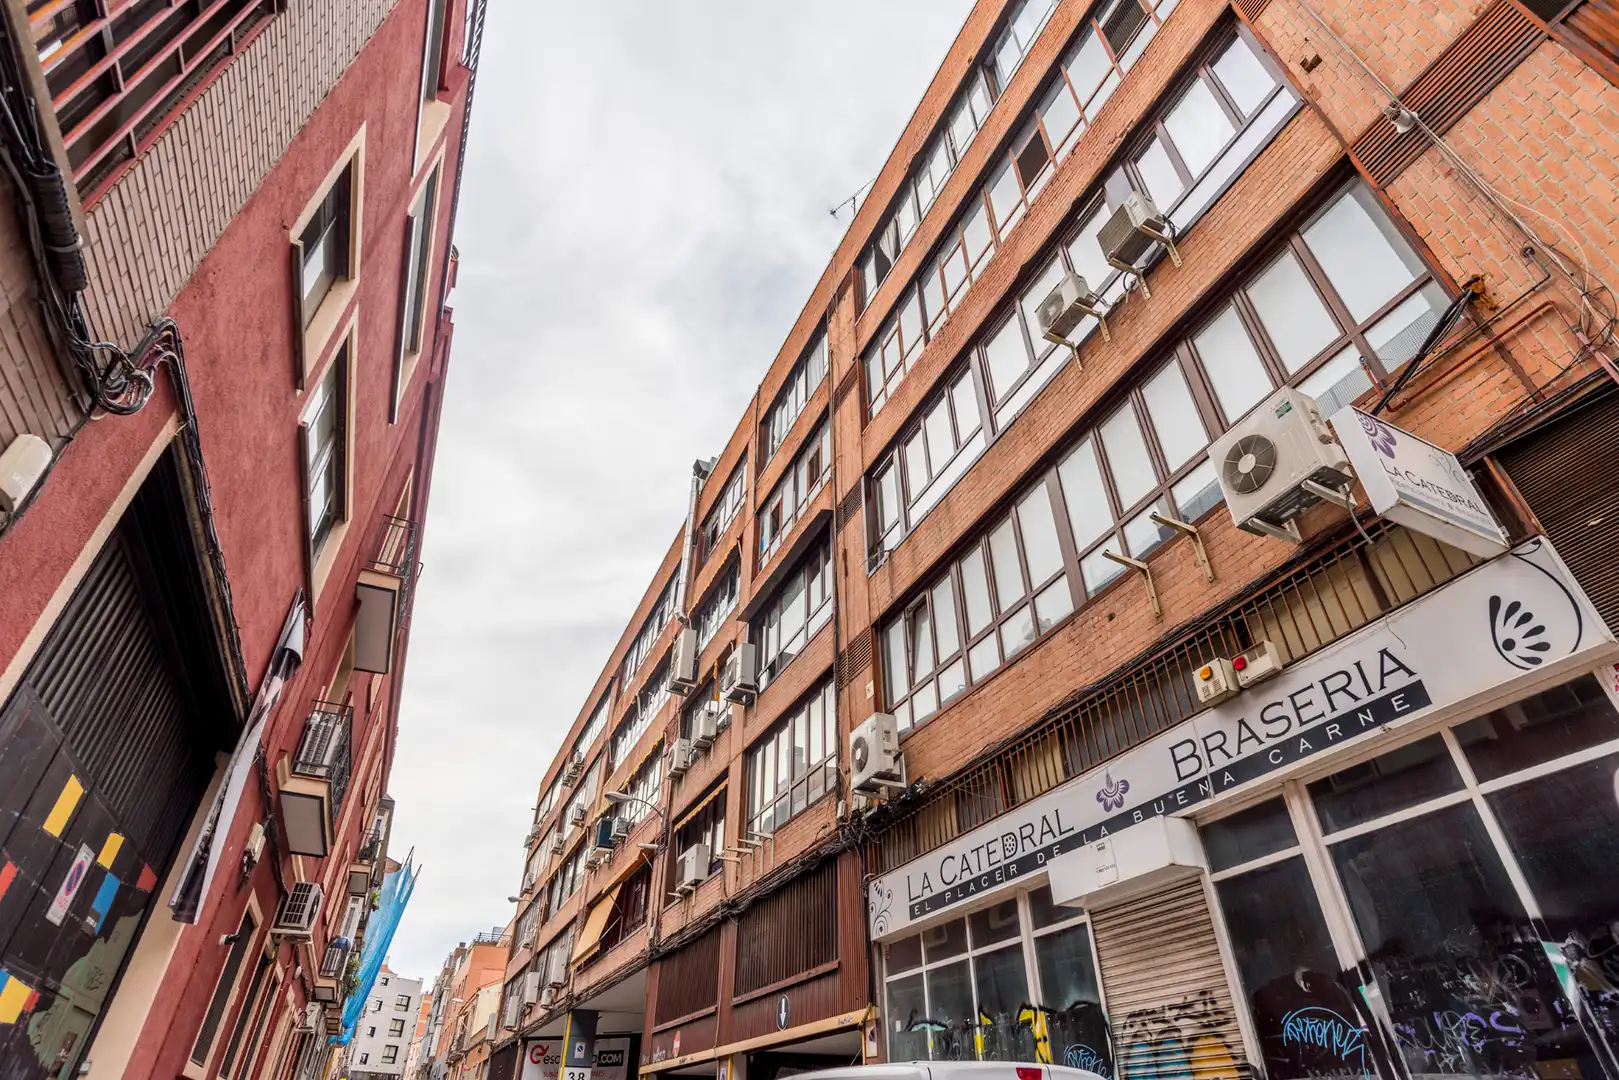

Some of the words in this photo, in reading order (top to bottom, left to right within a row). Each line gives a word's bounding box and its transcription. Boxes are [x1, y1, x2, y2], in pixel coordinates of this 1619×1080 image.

[1379, 458, 1405, 480] LA
[1405, 470, 1488, 515] CATEDRAL
[1168, 647, 1417, 783] BRASERIA
[906, 872, 934, 903] LA
[940, 808, 1075, 885] CATEDRAL
[913, 902, 931, 916] EL
[945, 864, 1018, 904] PLACER
[1037, 844, 1062, 864] DE
[1083, 825, 1110, 845] LA
[1132, 771, 1235, 824] BUENA
[1268, 693, 1410, 765] CARNE
